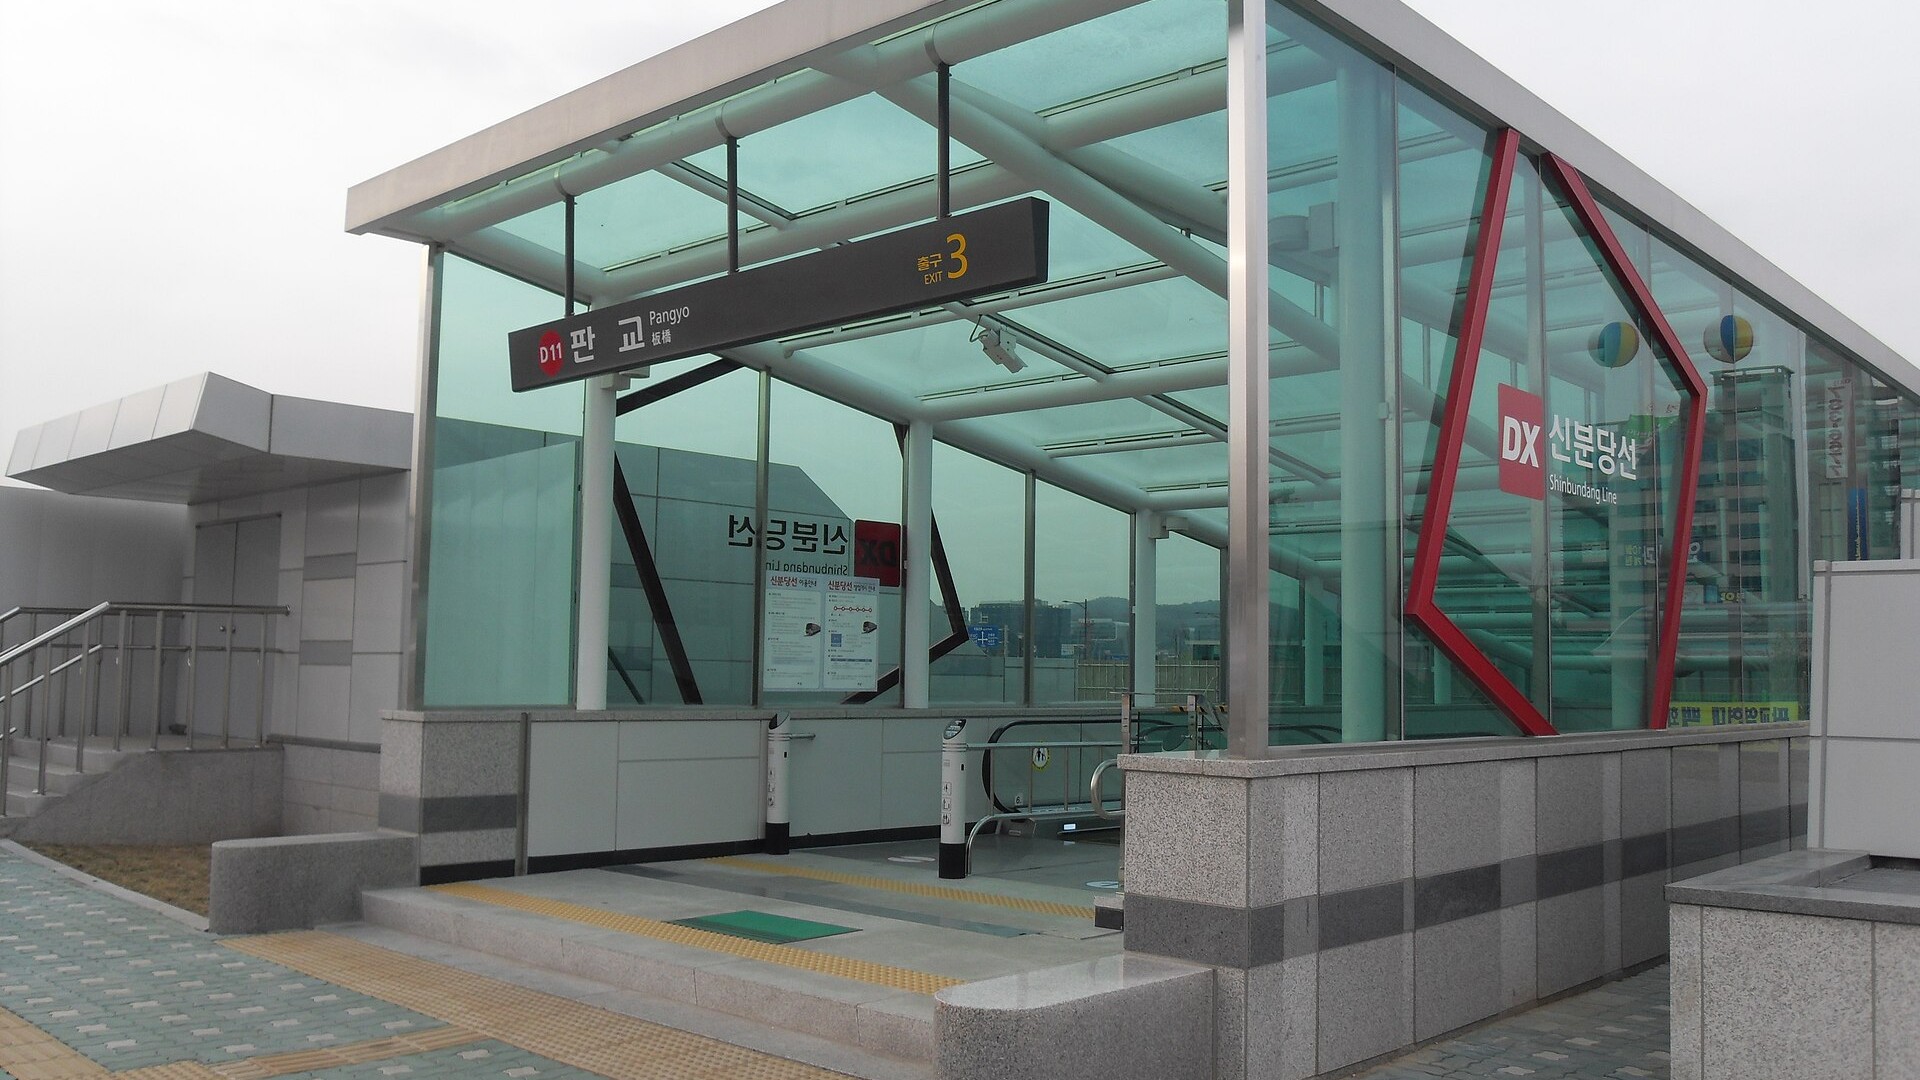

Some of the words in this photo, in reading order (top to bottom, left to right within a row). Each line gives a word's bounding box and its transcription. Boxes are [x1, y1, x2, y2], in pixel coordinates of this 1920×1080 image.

[917, 253, 943, 271] 출구
[946, 233, 968, 279] 3
[924, 271, 943, 285] EXIT
[649, 306, 690, 326] Pangyo
[651, 328, 672, 347] 板橋
[539, 342, 563, 364] D11
[1501, 415, 1541, 468] DX
[1548, 414, 1637, 481] 신분당선
[1549, 474, 1601, 505] Shinbundang
[1602, 486, 1617, 505] Line
